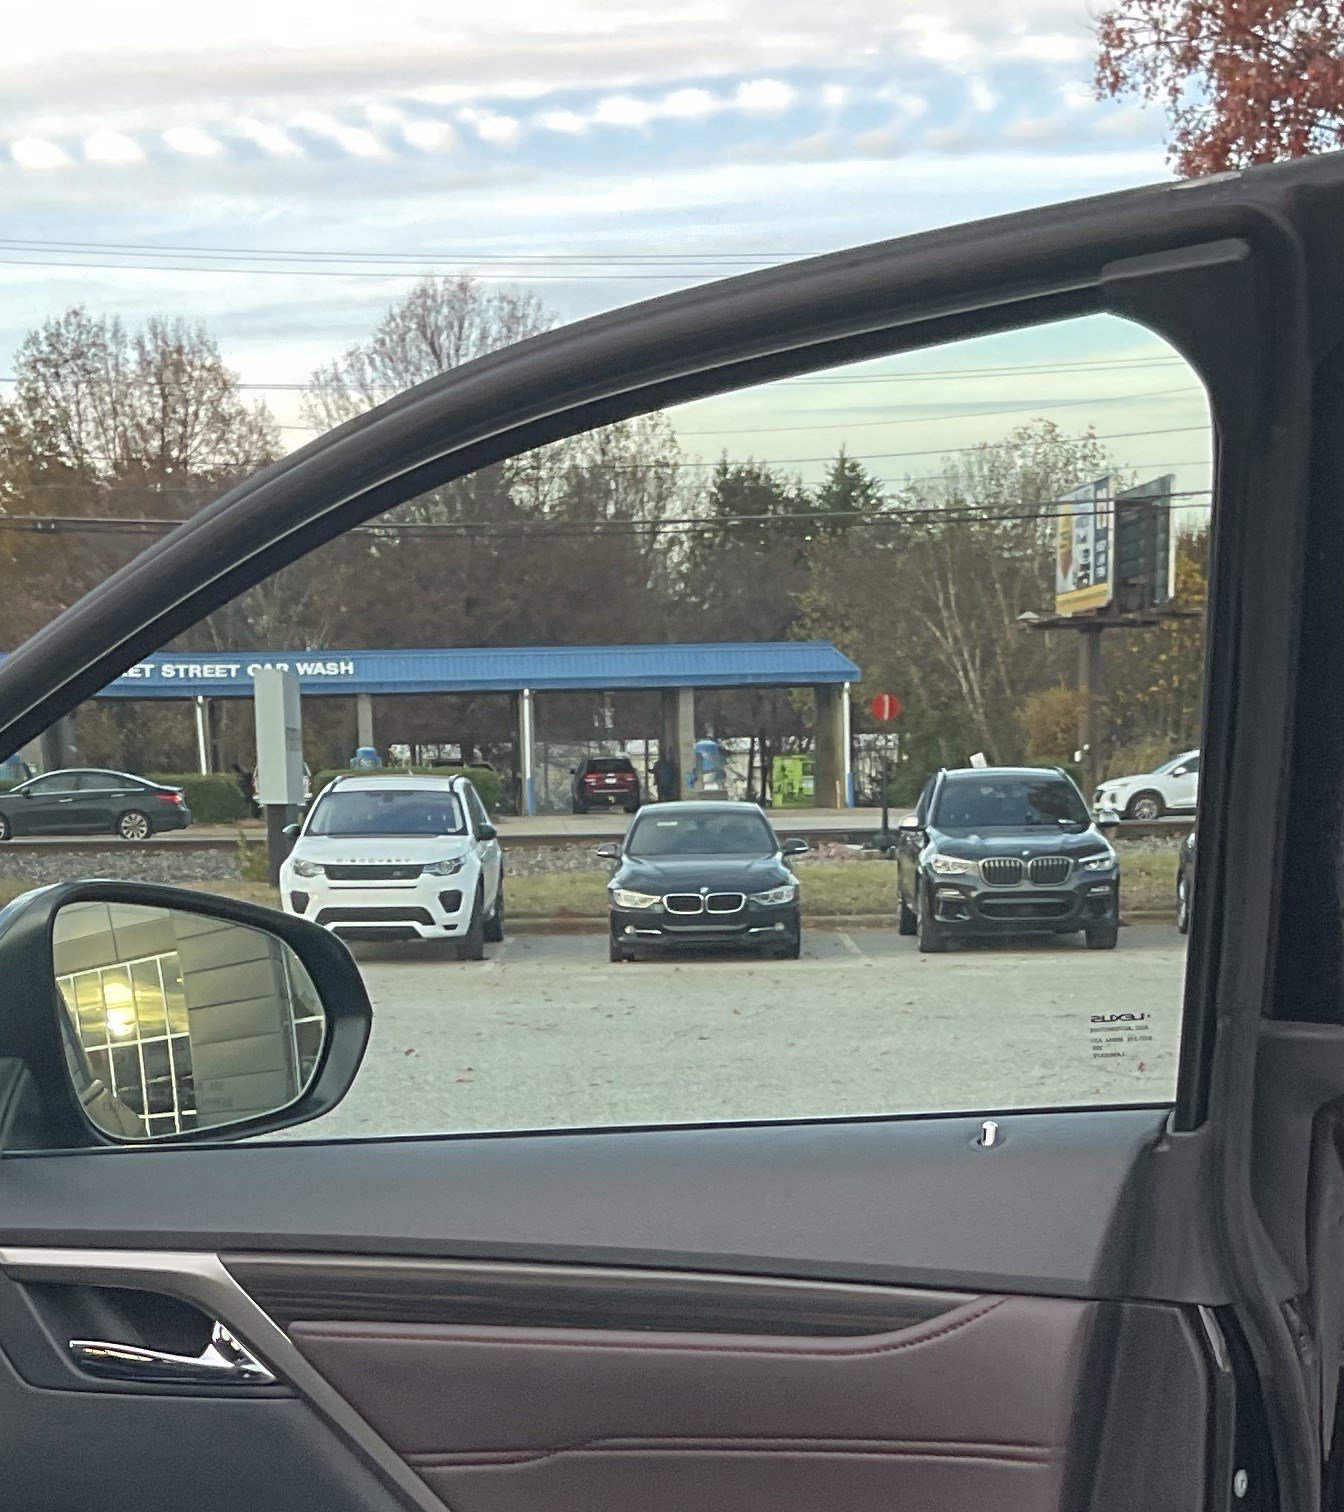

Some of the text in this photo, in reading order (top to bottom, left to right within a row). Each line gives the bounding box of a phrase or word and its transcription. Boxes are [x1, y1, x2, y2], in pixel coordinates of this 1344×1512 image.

[122, 664, 155, 678] ET
[161, 664, 240, 678] STREET
[296, 661, 354, 676] WASH
